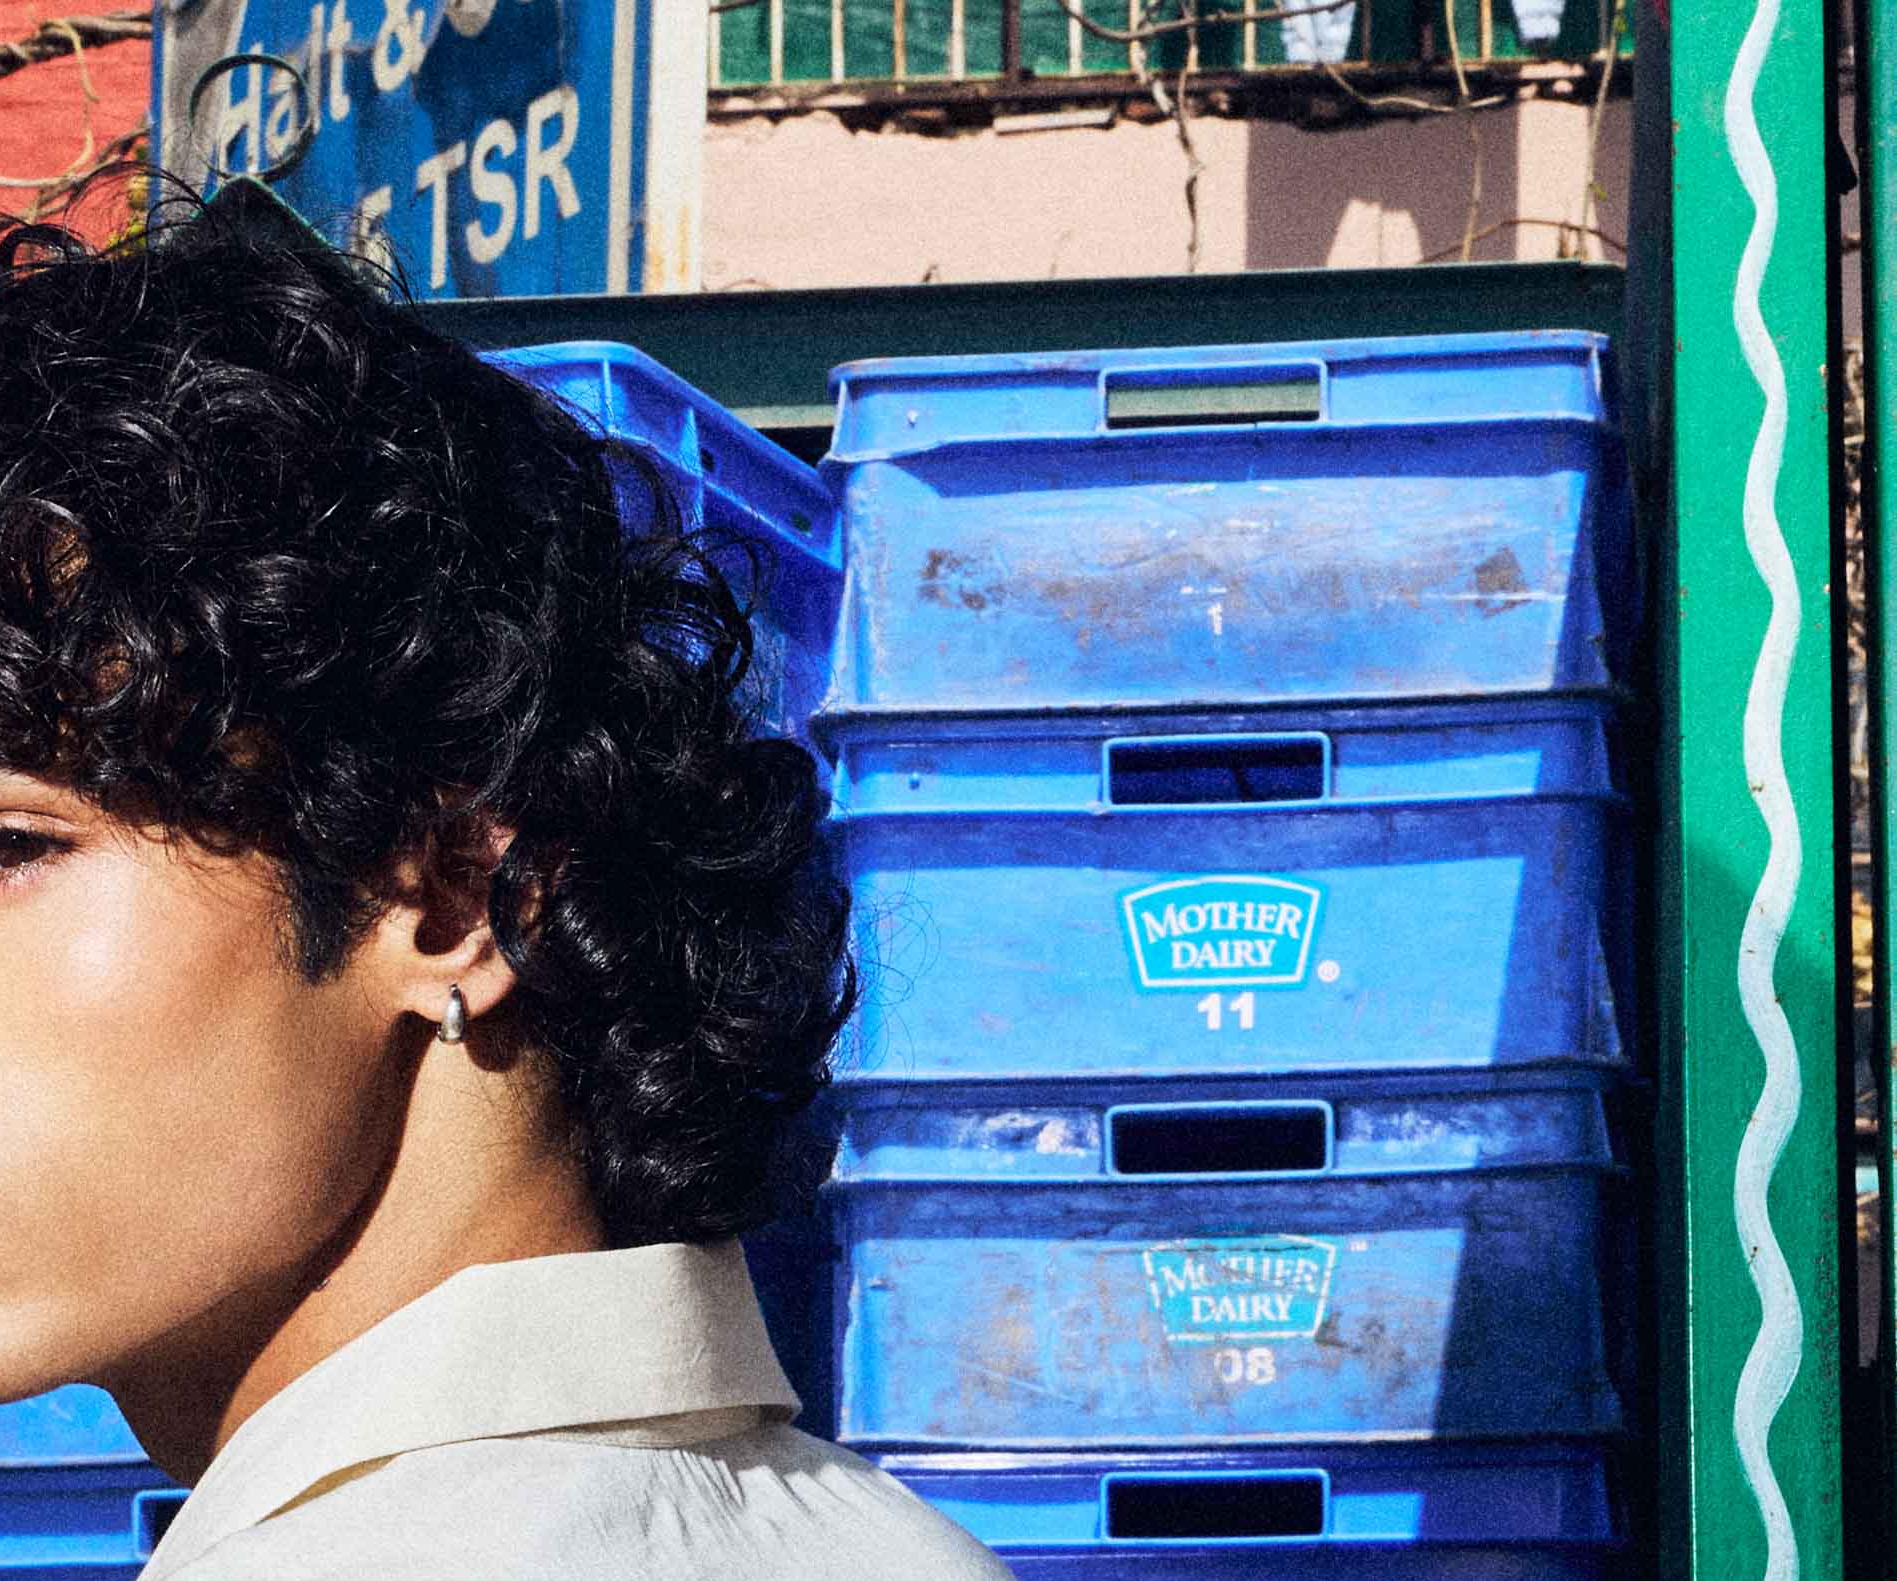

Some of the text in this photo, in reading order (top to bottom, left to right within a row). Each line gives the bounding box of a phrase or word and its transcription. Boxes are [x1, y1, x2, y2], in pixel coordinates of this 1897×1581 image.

[415, 86, 582, 289] TSR
[1141, 901, 1302, 944] MOTHER
[1171, 939, 1277, 969] DAIRY
[1197, 992, 1254, 1030] 11
[1191, 1294, 1294, 1323] DAIRY
